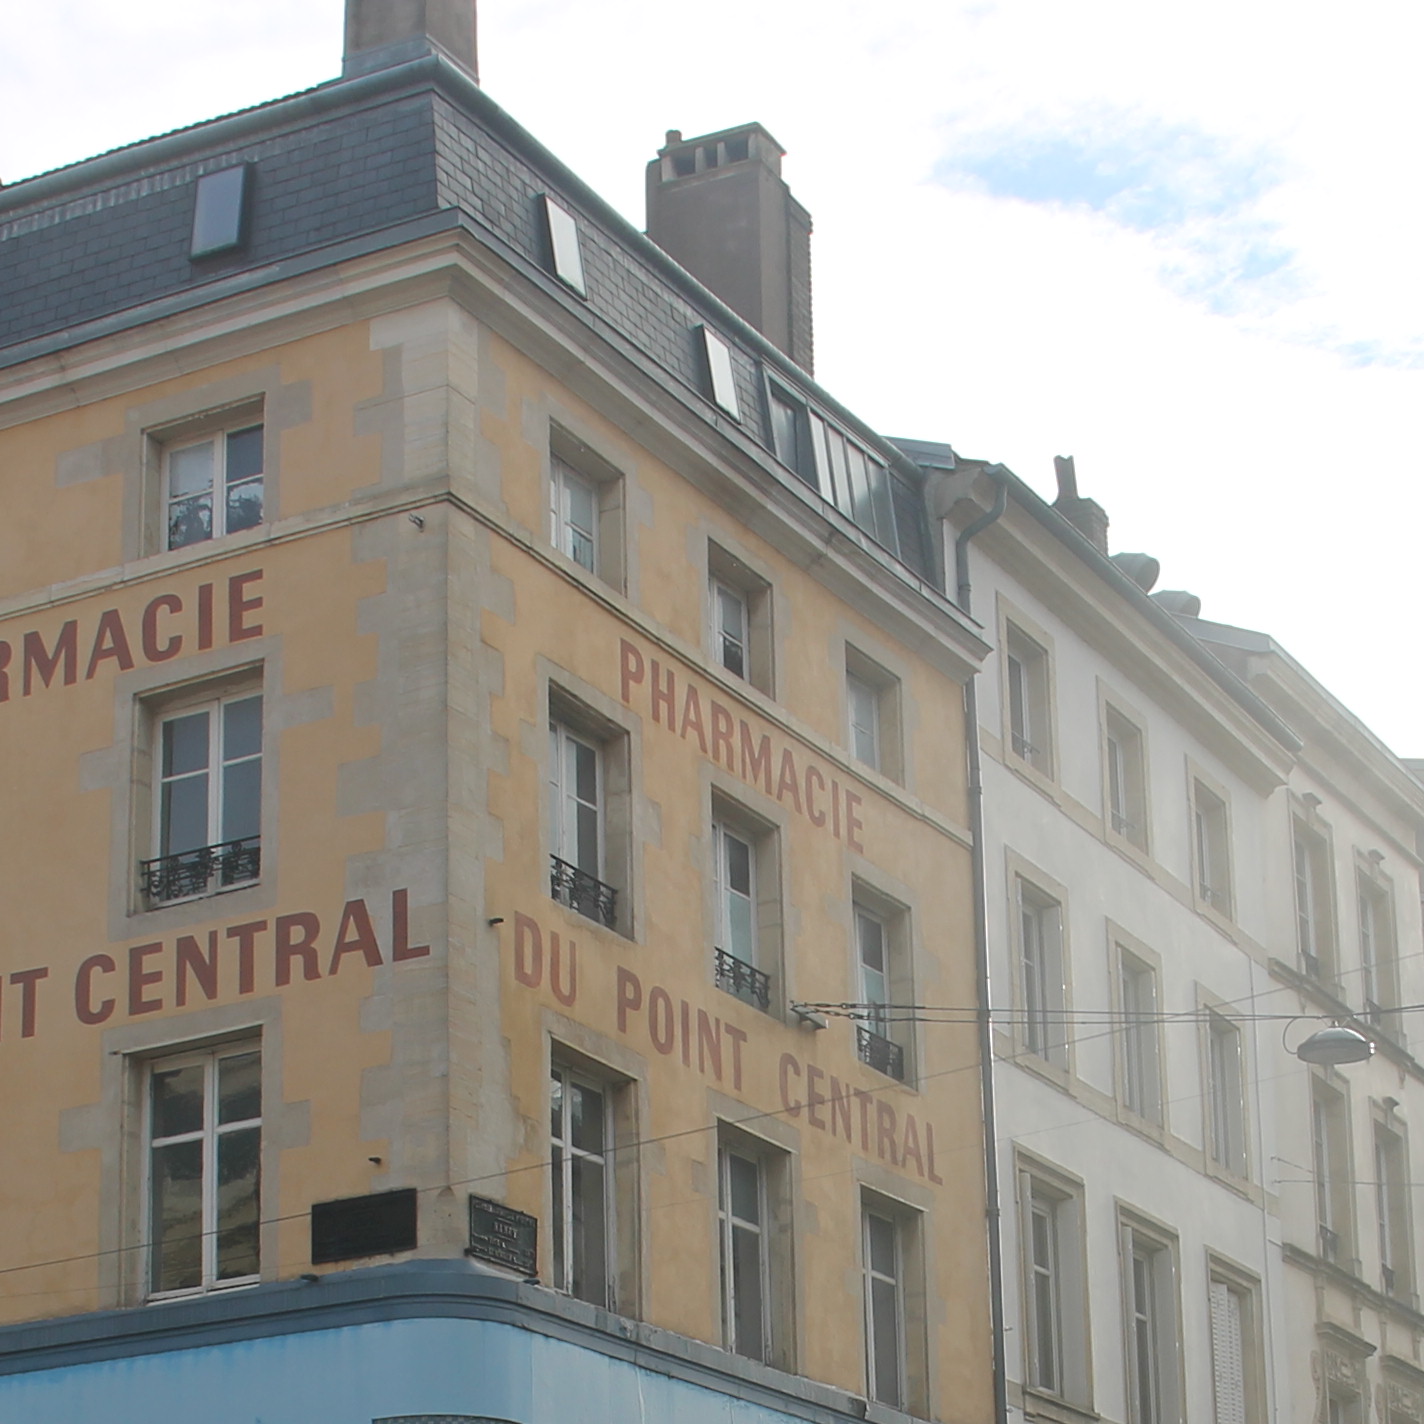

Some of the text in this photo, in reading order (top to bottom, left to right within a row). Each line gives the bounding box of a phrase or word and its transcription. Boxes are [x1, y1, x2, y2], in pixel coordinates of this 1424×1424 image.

[619, 637, 866, 856] PHARMACIE
[75, 887, 431, 1027] CENTRAL
[513, 910, 944, 1187] DU POINT CENTRAL
